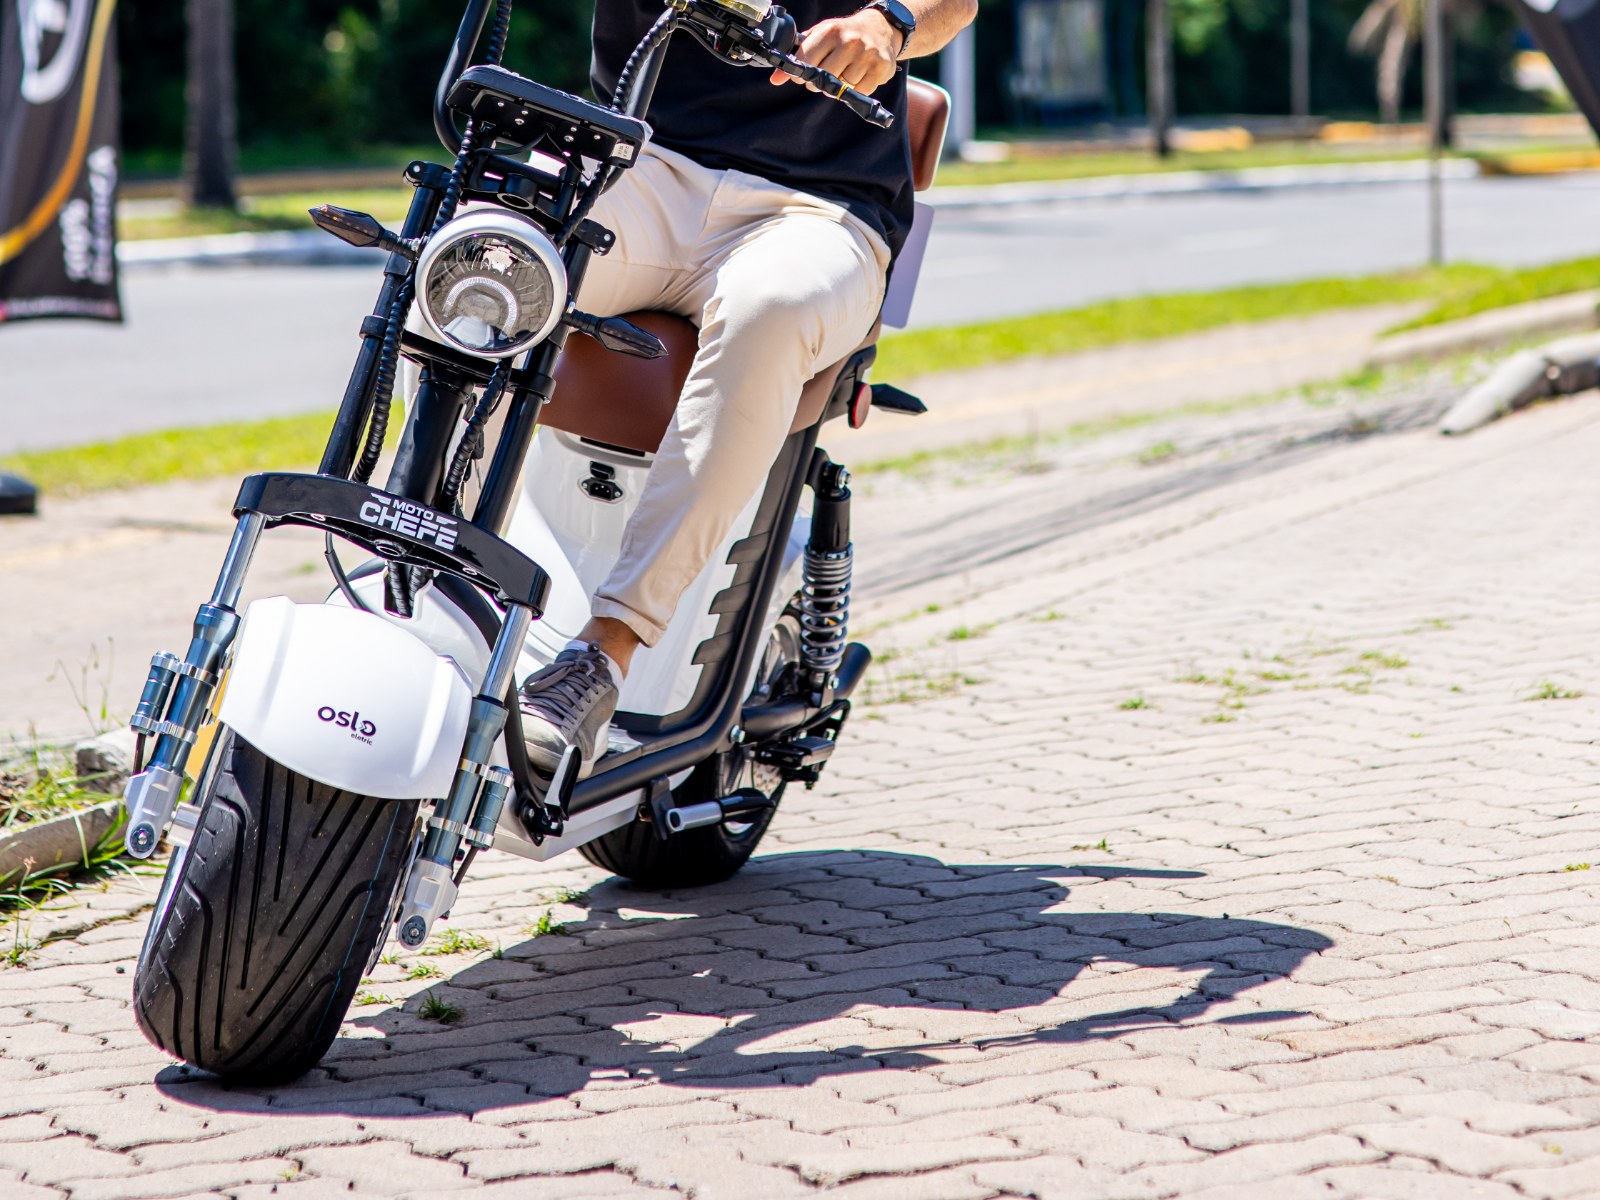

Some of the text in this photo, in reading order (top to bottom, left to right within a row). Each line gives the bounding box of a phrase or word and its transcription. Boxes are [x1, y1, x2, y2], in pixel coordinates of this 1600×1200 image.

[393, 499, 434, 521] MOTO
[360, 501, 458, 550] CHEFE
[317, 706, 377, 737] oslo
[350, 733, 373, 746] eletric
